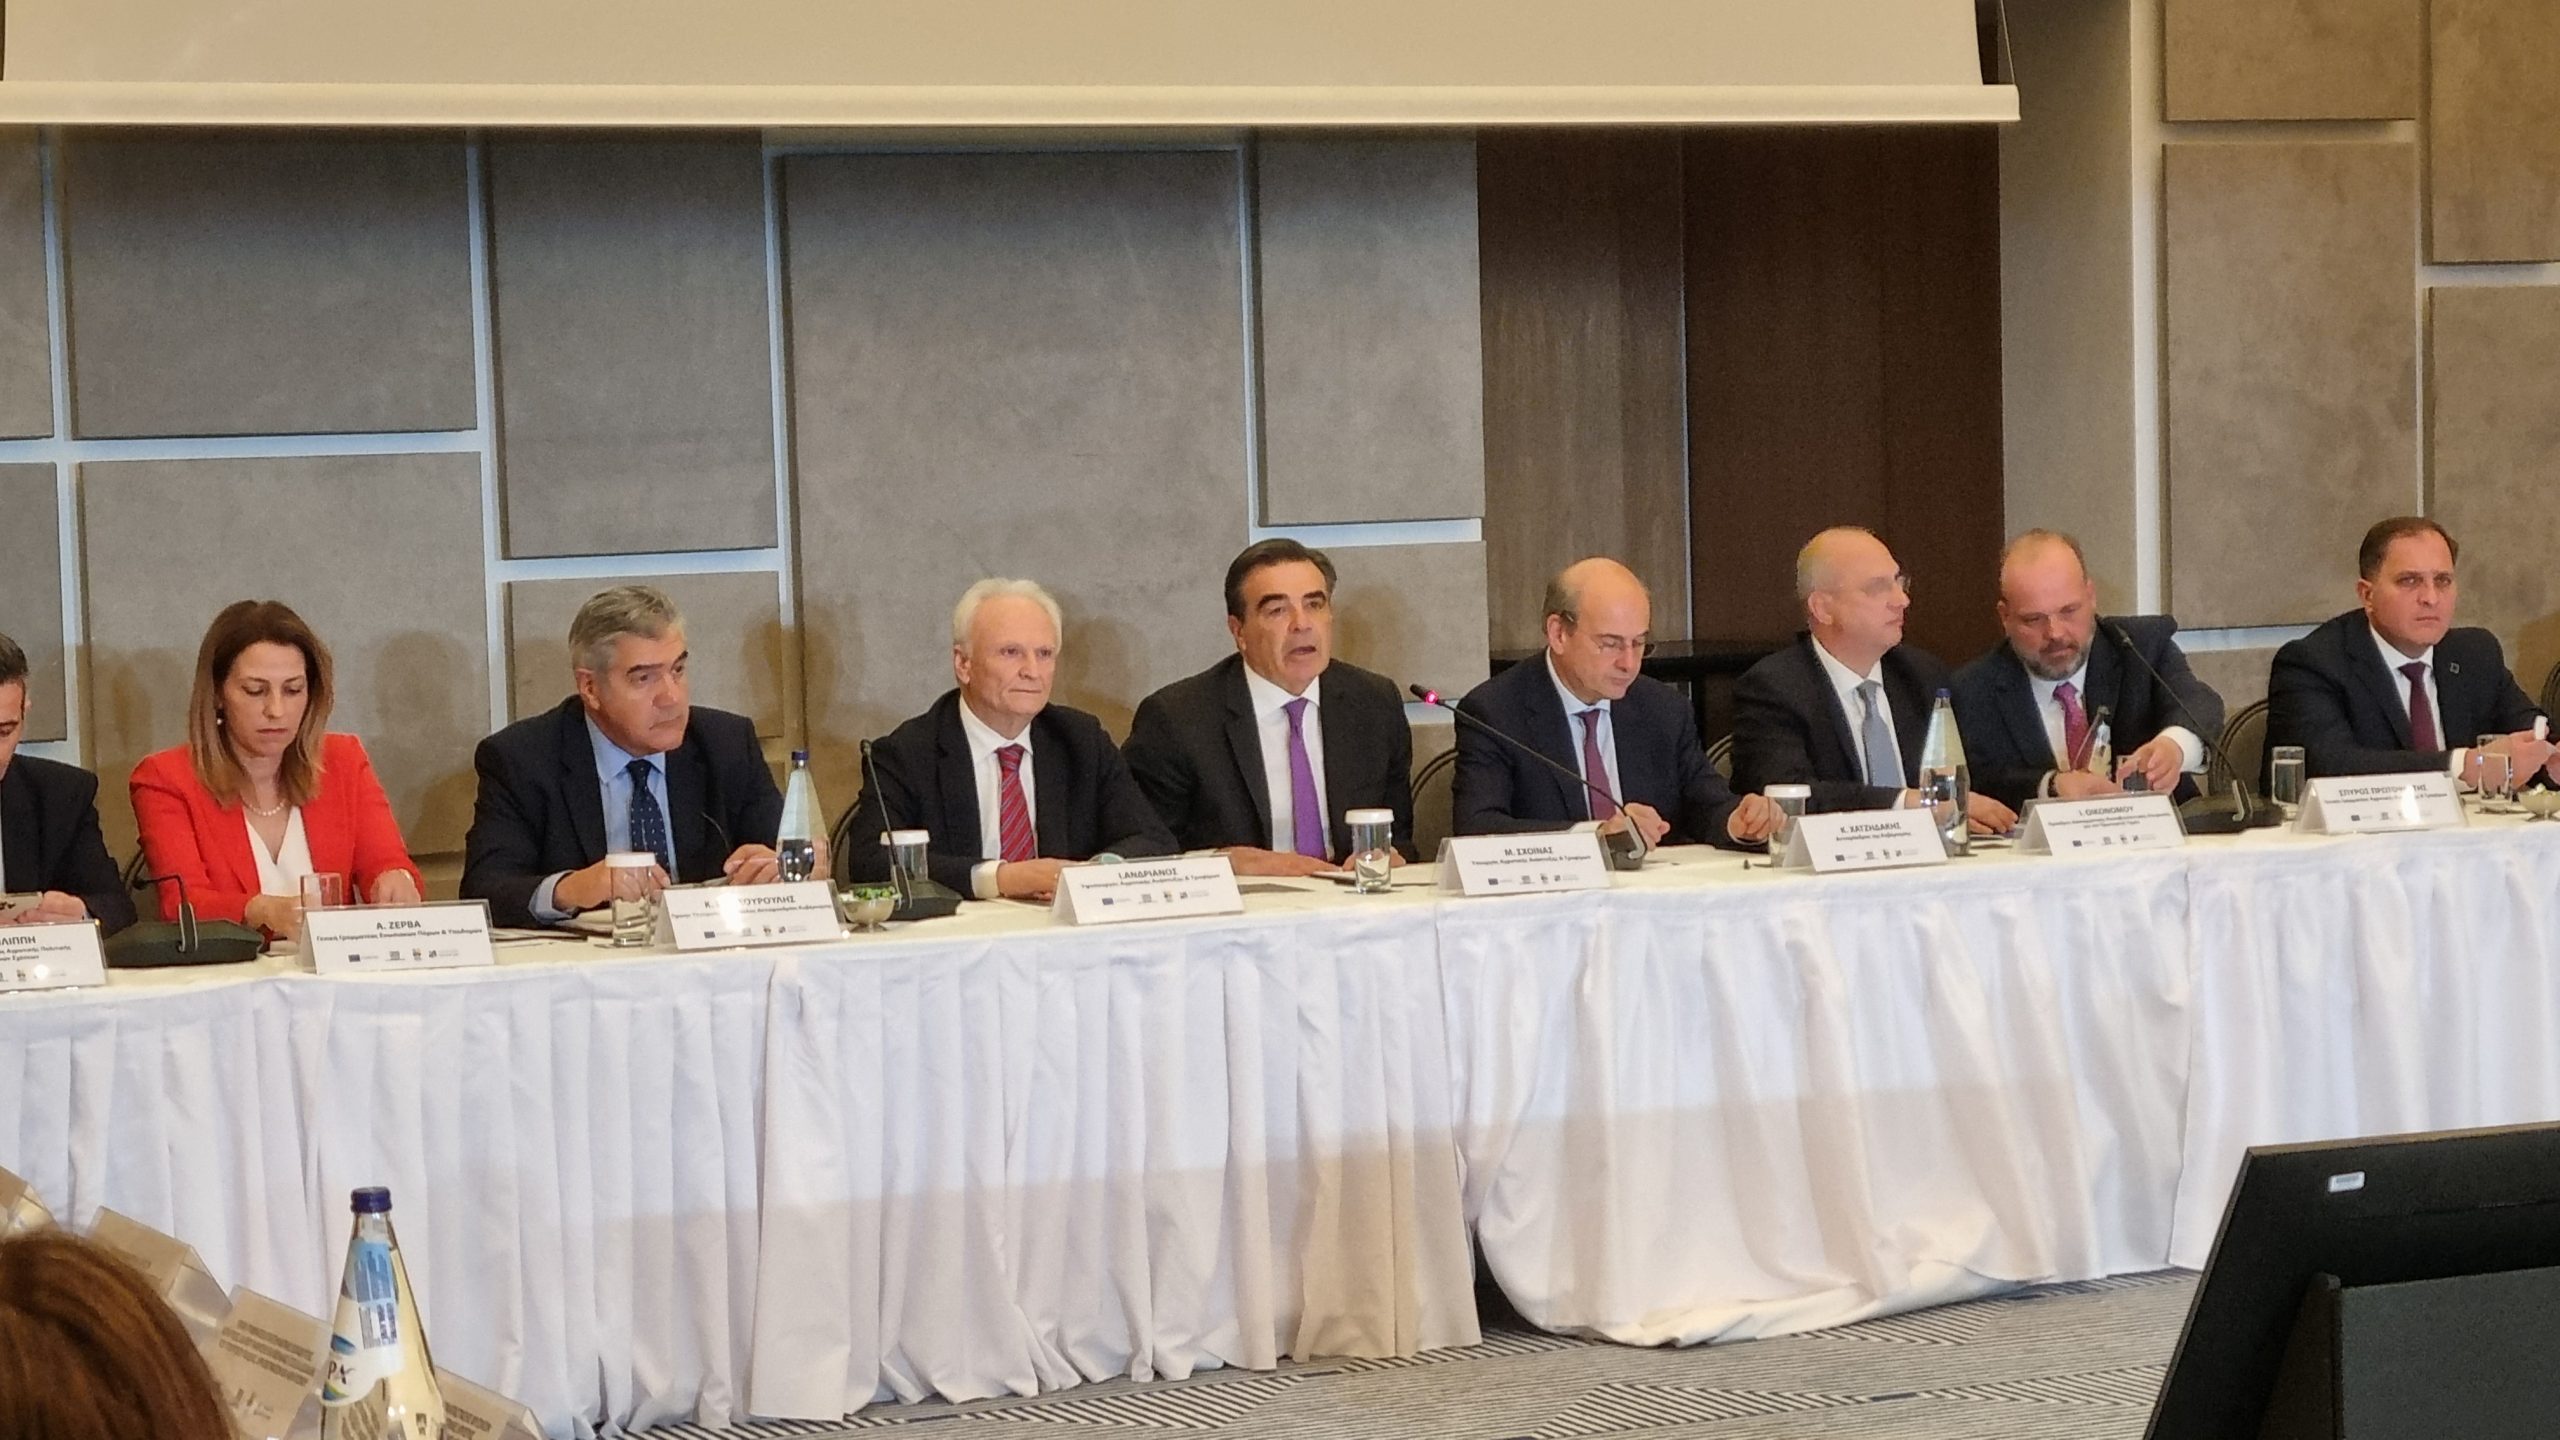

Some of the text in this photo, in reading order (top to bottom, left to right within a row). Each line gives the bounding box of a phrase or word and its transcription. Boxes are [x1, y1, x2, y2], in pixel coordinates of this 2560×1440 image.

[2338, 787, 2369, 797] ΣΠΥΡΟΣ
[2085, 806, 2133, 816] ΟΙΚΟΝΟΜΟΥ
[1850, 822, 1901, 833] ΧΑΤΖΗΔΑΚΗΣ
[1516, 846, 1553, 856] ΣΧΟΙΝΑΣ
[376, 919, 422, 930] Α. ΖΕΡΒΑ
